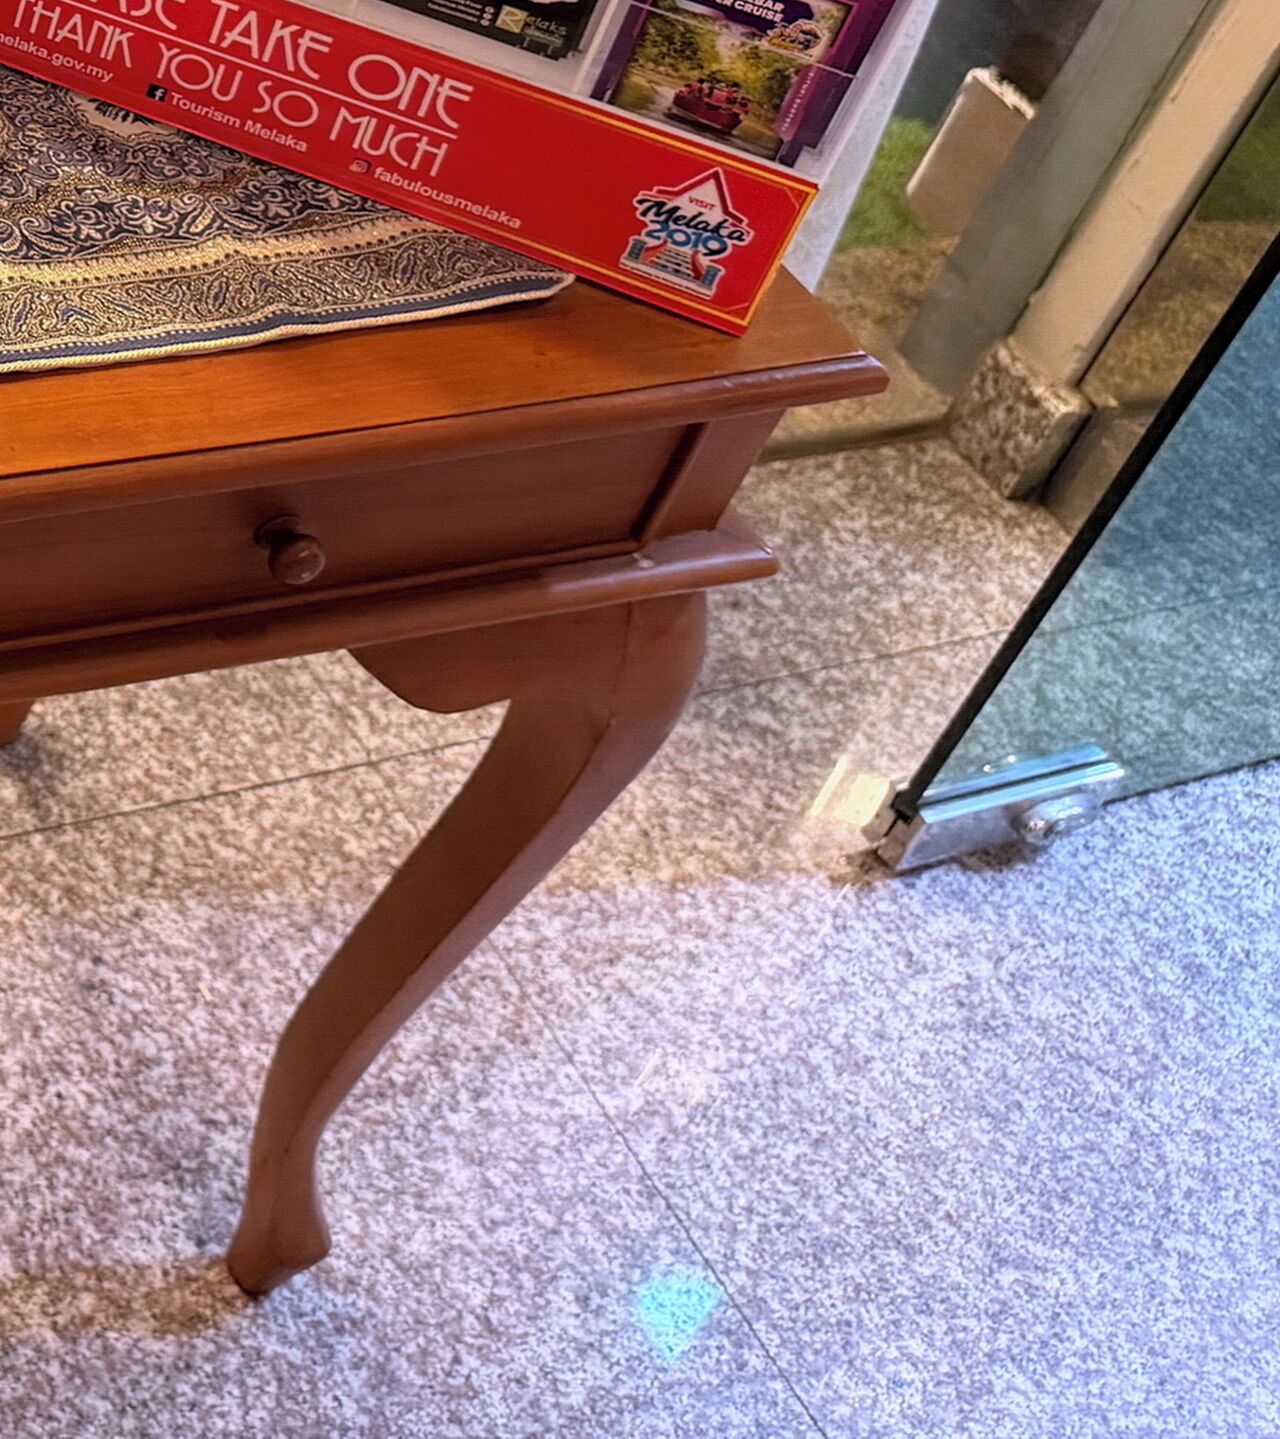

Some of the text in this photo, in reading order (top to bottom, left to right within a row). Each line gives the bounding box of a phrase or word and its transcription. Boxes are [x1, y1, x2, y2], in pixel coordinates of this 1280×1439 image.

[734, 2, 783, 21] CRUISE
[157, 42, 242, 101] YOU
[253, 80, 319, 127] SO
[329, 106, 448, 177] MUCH
[348, 54, 474, 129] ONE
[170, 92, 308, 153] Tourism Melaka
[374, 167, 522, 230] fabulousmelaka
[637, 198, 746, 242] Melaka
[646, 220, 728, 256] 2019
